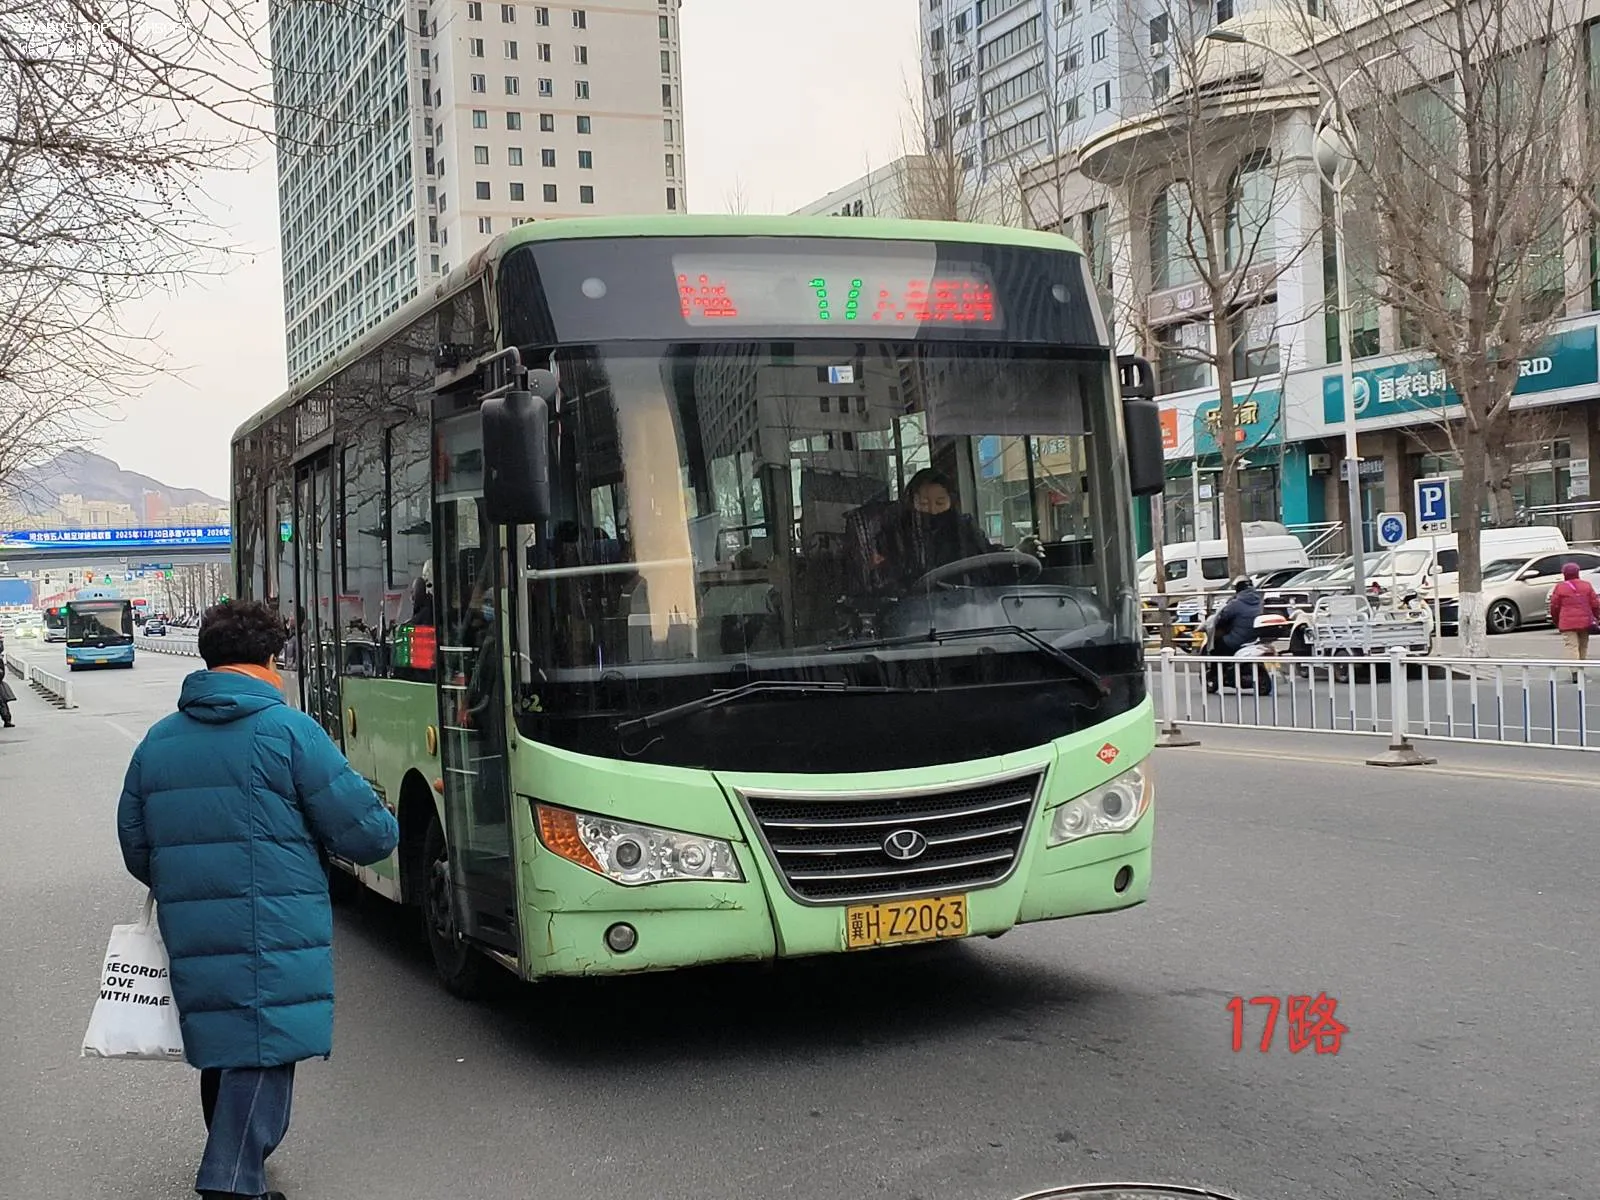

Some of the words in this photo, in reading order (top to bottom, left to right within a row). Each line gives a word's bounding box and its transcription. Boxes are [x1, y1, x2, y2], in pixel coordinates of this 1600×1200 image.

[1378, 368, 1447, 403] 国家电网
[1422, 486, 1442, 517] P
[1100, 747, 1117, 759] CNG
[102, 976, 135, 988] OVE
